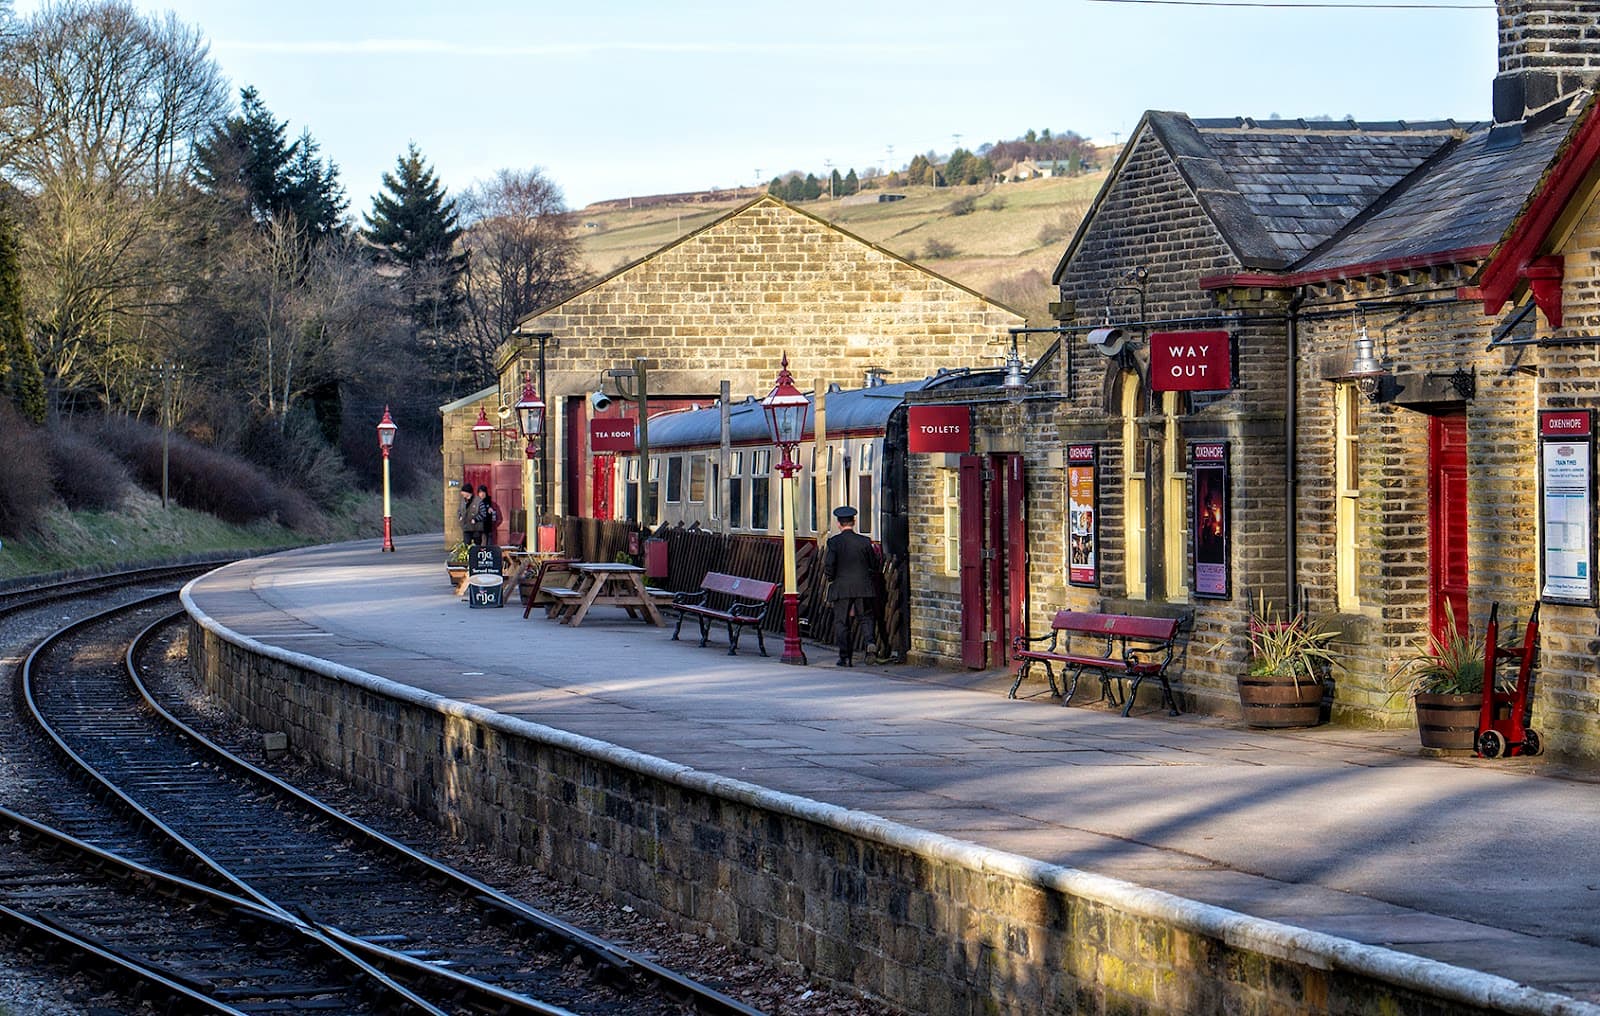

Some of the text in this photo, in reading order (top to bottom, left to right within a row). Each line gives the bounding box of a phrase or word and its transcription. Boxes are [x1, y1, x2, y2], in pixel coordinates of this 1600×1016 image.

[1169, 346, 1209, 357] WAY
[1171, 365, 1207, 376] OUT
[1549, 418, 1582, 429] OXENHOPE
